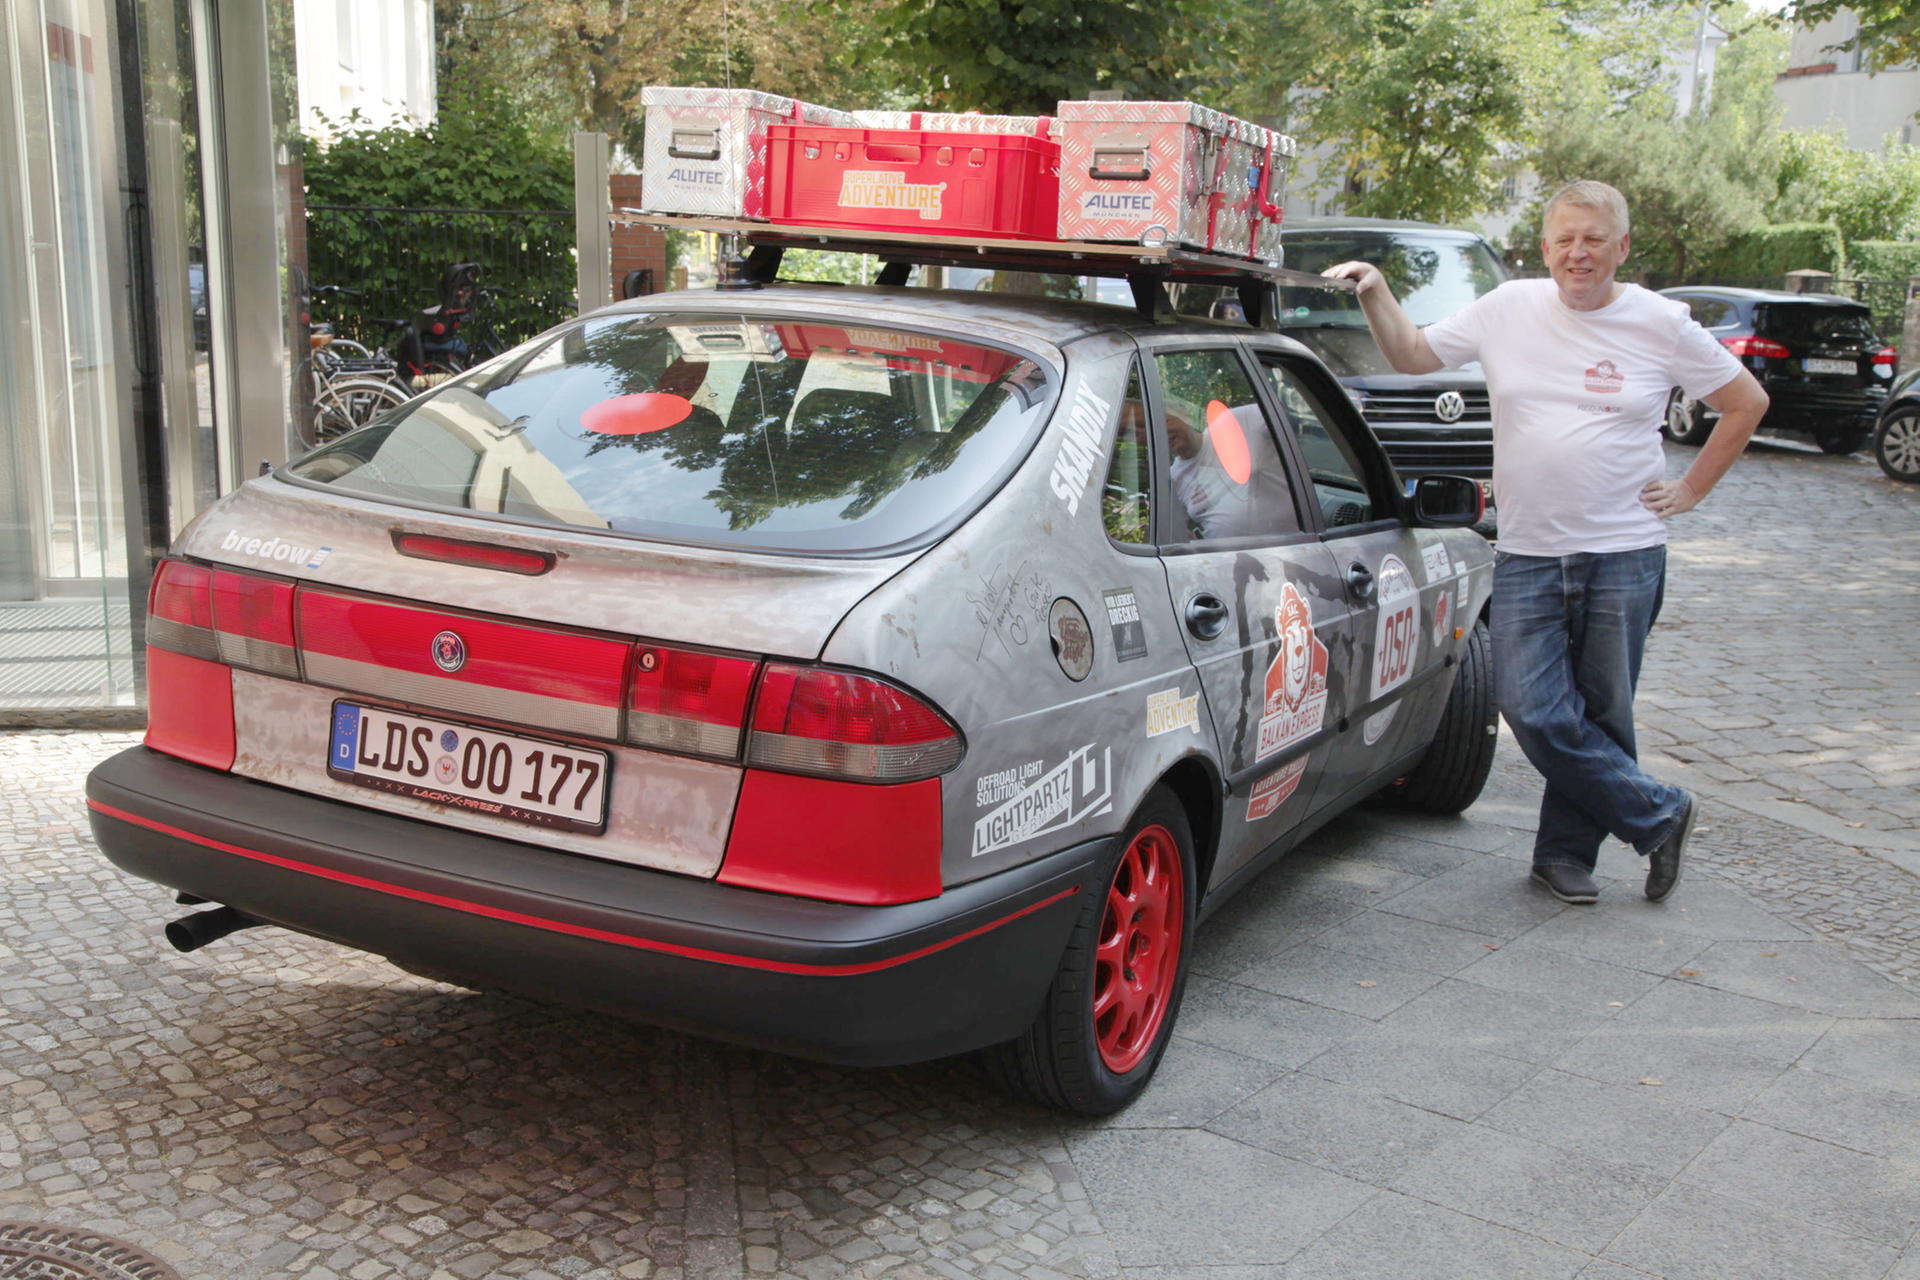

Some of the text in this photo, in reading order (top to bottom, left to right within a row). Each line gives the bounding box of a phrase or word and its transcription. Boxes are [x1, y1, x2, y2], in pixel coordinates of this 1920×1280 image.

[667, 168, 723, 185] ALUTEC
[839, 183, 941, 209] ADVENTURE
[1084, 194, 1152, 210] ALUTEC
[1049, 378, 1110, 518] SKANDIX
[221, 529, 312, 565] bredow
[1147, 698, 1197, 734] ADVENTURE
[1260, 702, 1321, 751] BALKAN EXPRESS
[358, 716, 433, 778] LDS
[520, 750, 600, 811] 177
[977, 759, 1044, 792] OFFROAD LIGHT
[975, 768, 1071, 853] LIGHTPARTZ
[976, 779, 1027, 808] SOLUTIONS
